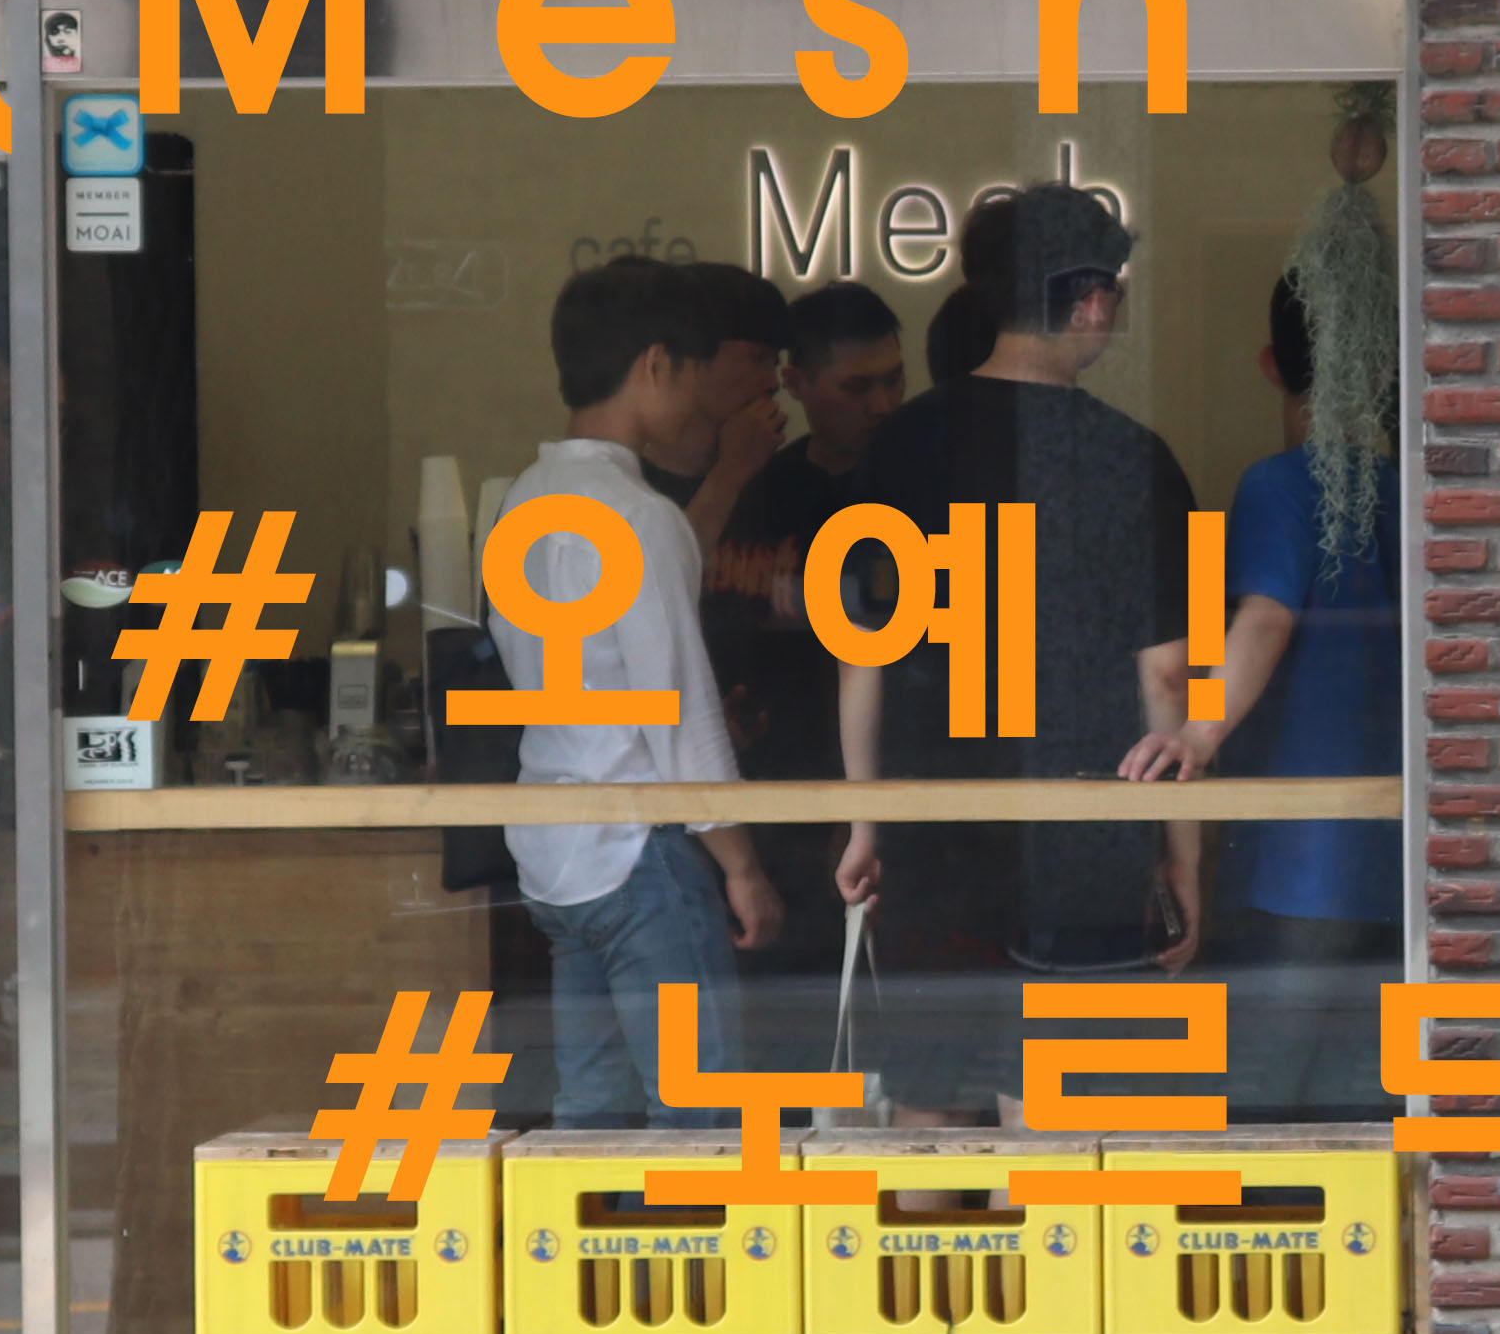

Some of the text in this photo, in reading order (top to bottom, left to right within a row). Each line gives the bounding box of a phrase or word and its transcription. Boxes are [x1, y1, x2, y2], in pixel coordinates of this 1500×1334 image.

[75, 190, 130, 200] MEMBER
[749, 142, 1127, 278] Me
[76, 224, 131, 242] MOAI
[95, 569, 128, 587] ACE
[273, 1238, 411, 1256] CLUB-MATE
[580, 1236, 719, 1254] CLUB-MATE
[881, 1233, 1019, 1252] CLUB-MATE
[1179, 1231, 1318, 1249] CLUB-MATE
